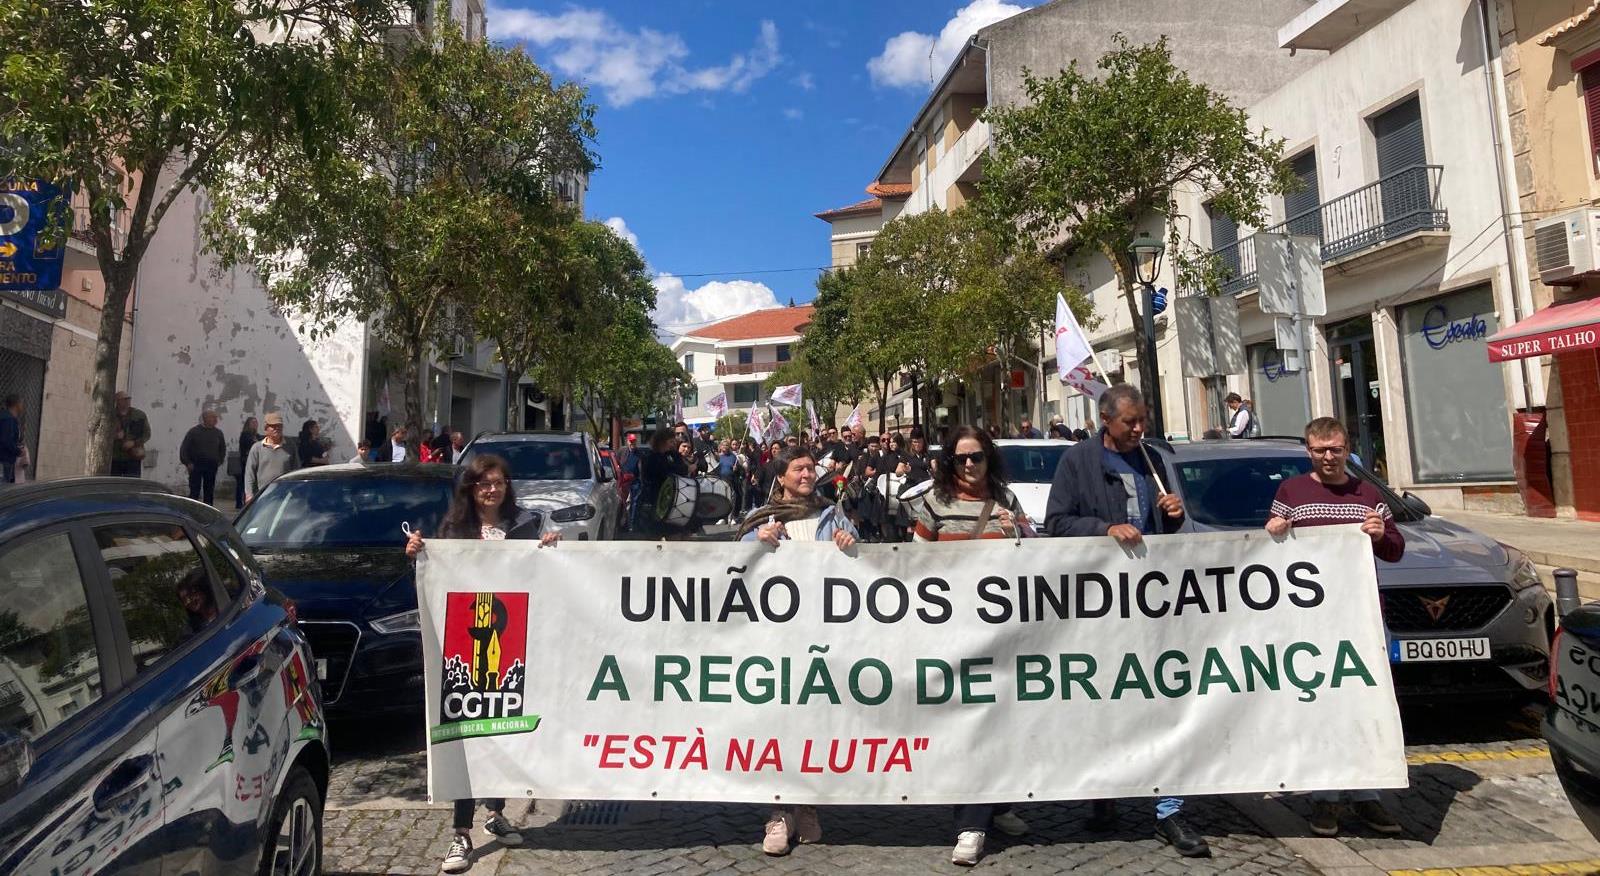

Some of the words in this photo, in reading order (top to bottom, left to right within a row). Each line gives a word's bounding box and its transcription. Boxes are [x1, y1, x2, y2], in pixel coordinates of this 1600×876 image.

[1501, 340, 1541, 357] SUPER
[1548, 330, 1596, 350] TALHO
[620, 565, 800, 623] UNIÃO
[823, 576, 953, 625] DOS
[975, 561, 1326, 624] SINDICATOS
[587, 655, 630, 700] A
[654, 644, 893, 705] REGIÃO
[916, 657, 996, 704] DE
[1016, 639, 1377, 702] BRAGANÇA
[443, 691, 523, 719] CGTP
[491, 720, 529, 731] NACIONAL
[725, 738, 783, 772] NA
[800, 737, 930, 774] LUTA"
